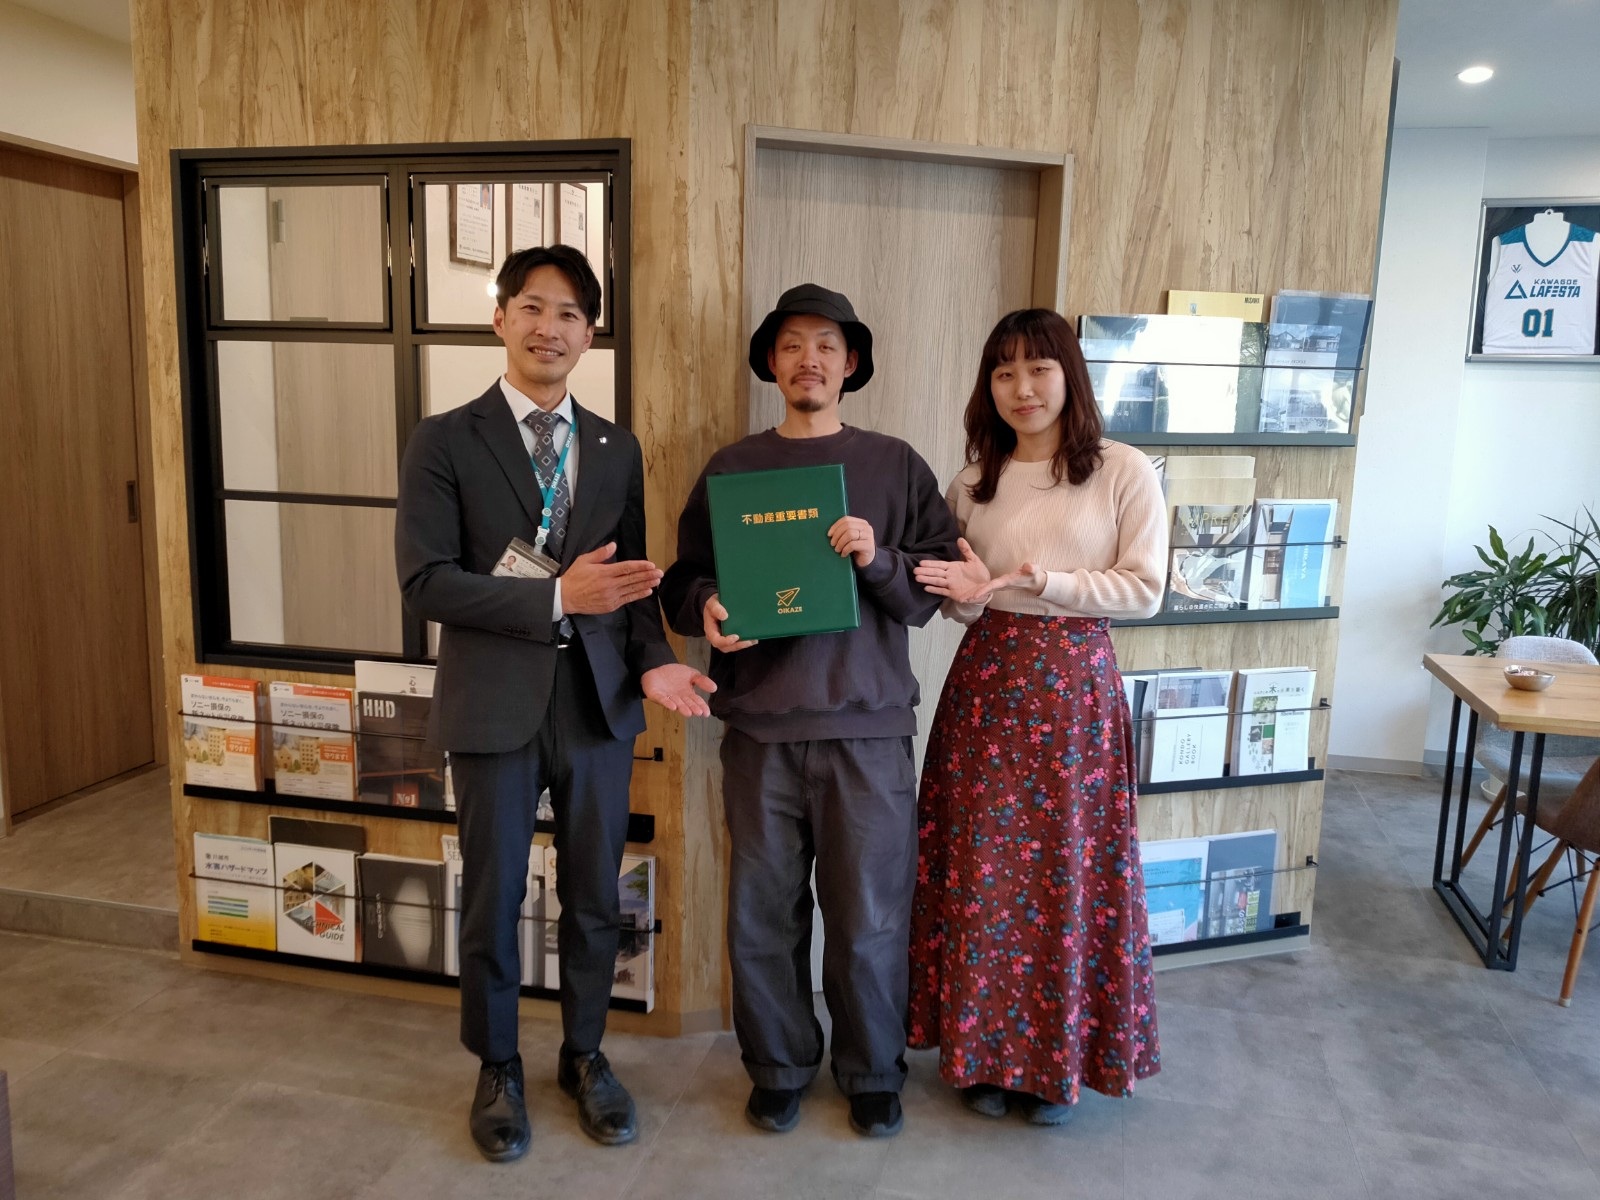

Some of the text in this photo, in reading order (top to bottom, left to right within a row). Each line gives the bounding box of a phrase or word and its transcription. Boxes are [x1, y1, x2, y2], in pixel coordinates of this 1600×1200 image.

[1529, 285, 1581, 298] LAFESTA
[1522, 308, 1554, 337] 01
[741, 508, 819, 525] 不動産重要書類
[777, 606, 803, 614] OIKAZE
[362, 698, 396, 718] HHD
[303, 918, 345, 932] TECHNICAL
[319, 932, 344, 941] GUIDE
